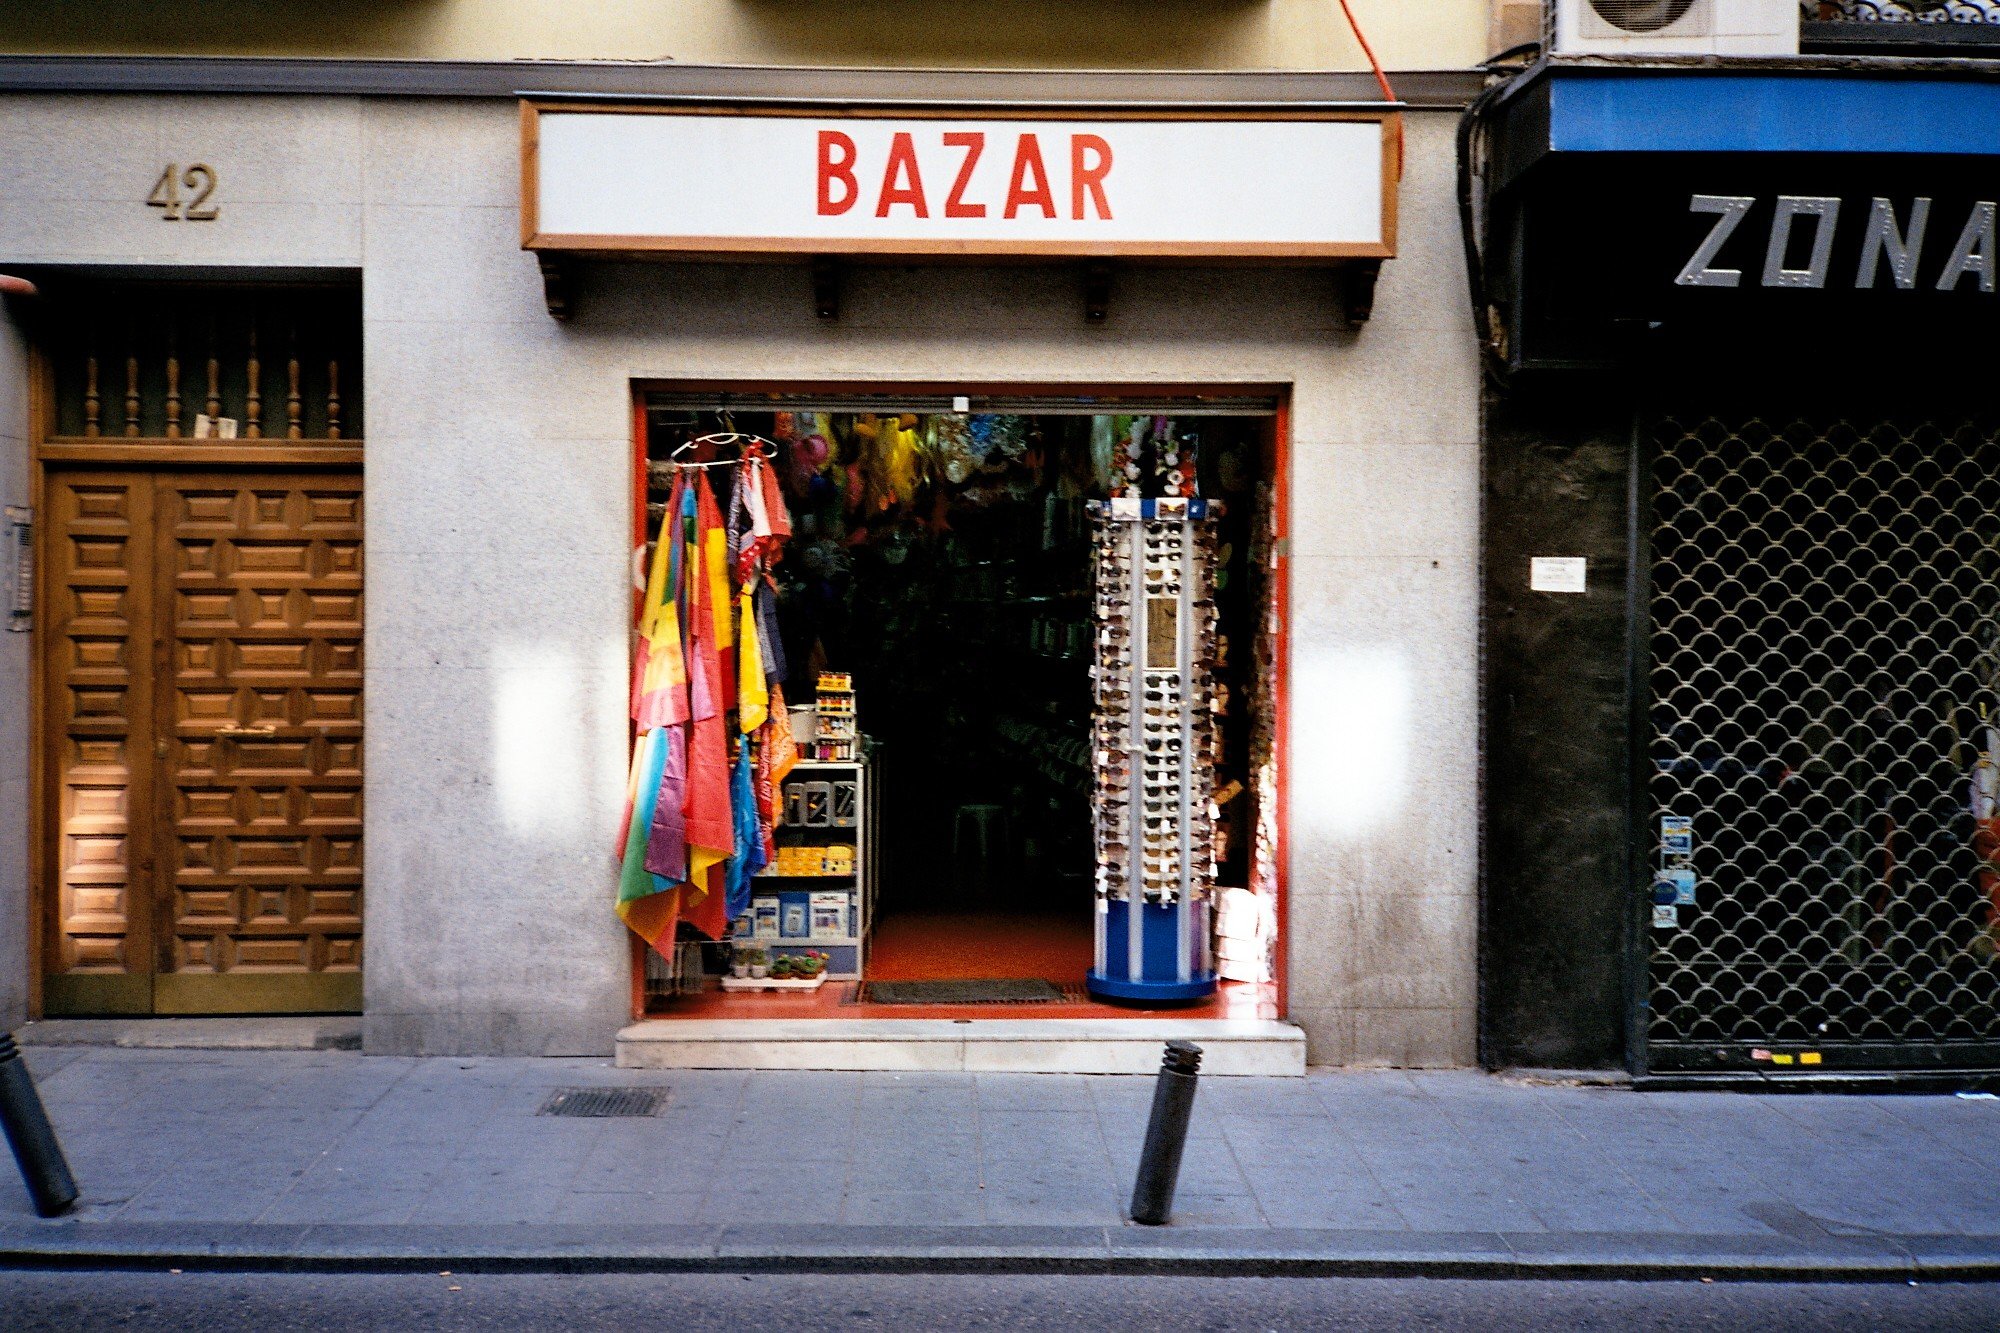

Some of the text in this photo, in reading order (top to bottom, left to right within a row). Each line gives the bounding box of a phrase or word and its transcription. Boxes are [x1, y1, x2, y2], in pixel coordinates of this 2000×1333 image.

[146, 163, 220, 221] 42
[817, 130, 1114, 220] BAZAR
[1673, 194, 1998, 293] ZONA
